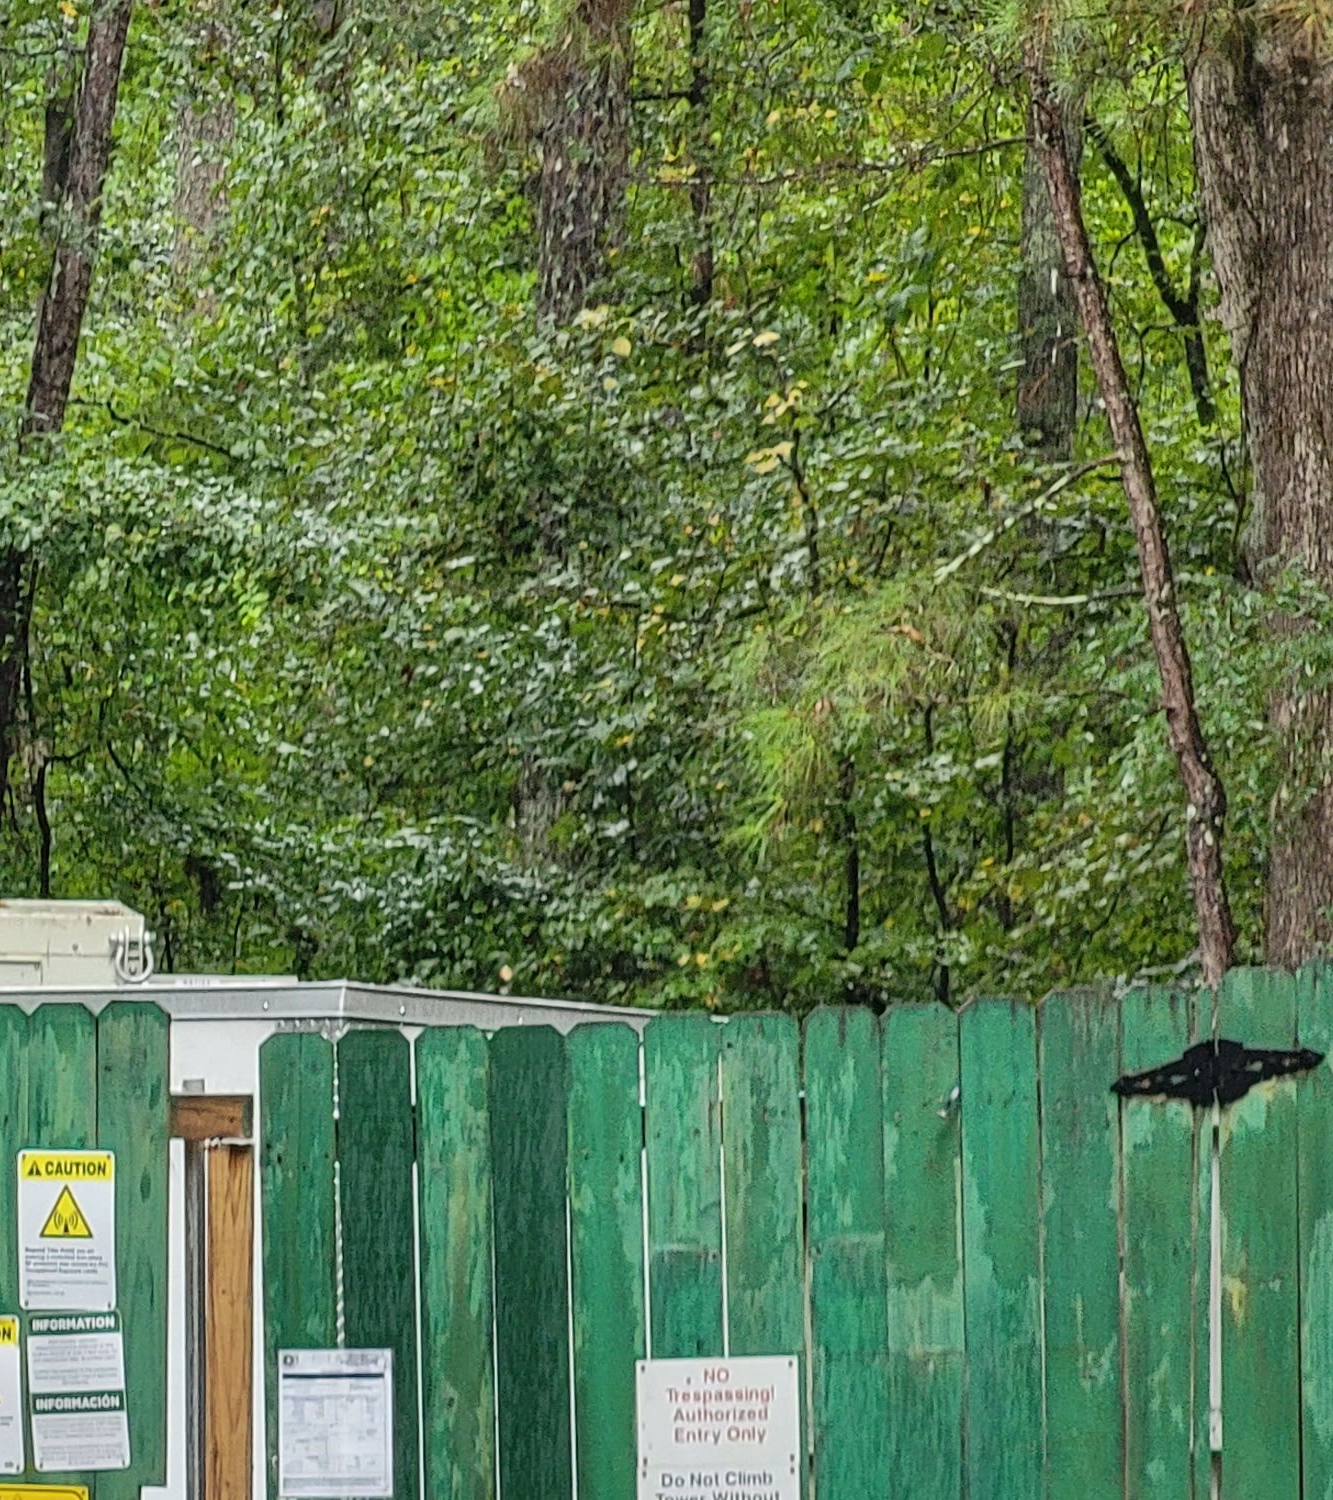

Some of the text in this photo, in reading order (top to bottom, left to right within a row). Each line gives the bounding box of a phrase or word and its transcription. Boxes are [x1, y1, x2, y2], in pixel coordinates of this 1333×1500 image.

[45, 1161, 106, 1176] CAUTION
[32, 1316, 115, 1331] INFORMATION
[703, 1368, 730, 1384] NO
[35, 1393, 120, 1411] INFORMACIÓN
[673, 1407, 769, 1423] Authorized
[674, 1425, 767, 1445] Entry Only
[661, 1470, 773, 1488] Do Not Climb
